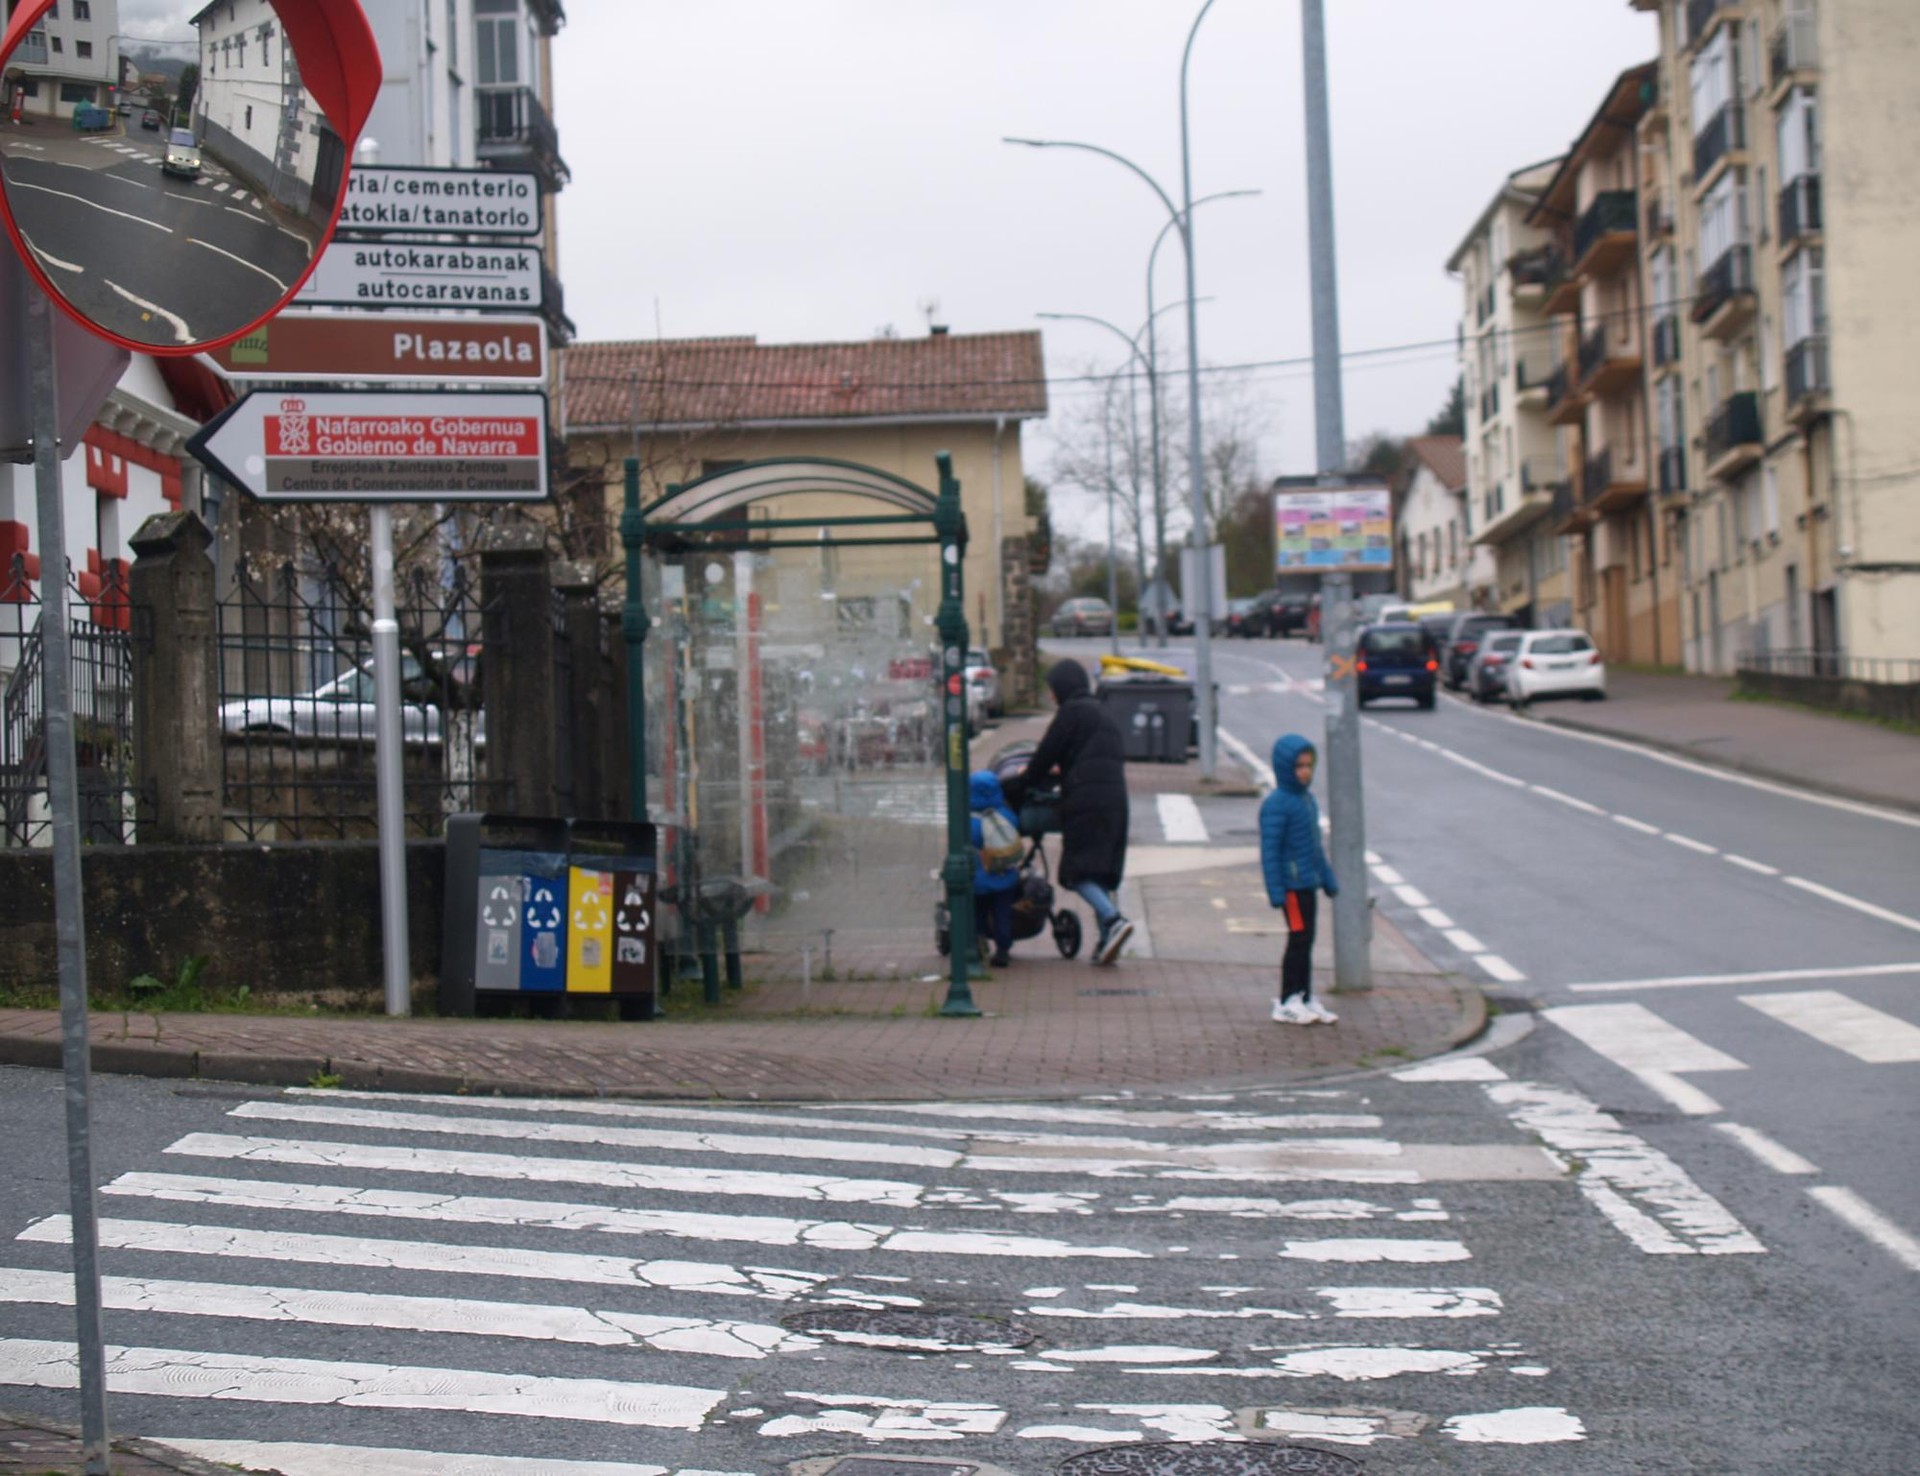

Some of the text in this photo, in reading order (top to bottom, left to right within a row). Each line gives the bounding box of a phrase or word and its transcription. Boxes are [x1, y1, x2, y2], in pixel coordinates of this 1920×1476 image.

[349, 174, 529, 197] ria/cementerio
[340, 203, 529, 226] atokia/tanatorio
[355, 249, 530, 271] autokarabanak
[357, 279, 530, 301] autocaravanas
[393, 333, 534, 362] Plazaola
[316, 417, 525, 436] Nafarroako Gobernua
[316, 436, 518, 454] Gobierno de Navarra
[311, 461, 507, 475] Errepideak Zaintzeko Zentroa
[282, 476, 537, 490] Centro de Conservación de Carreteras
